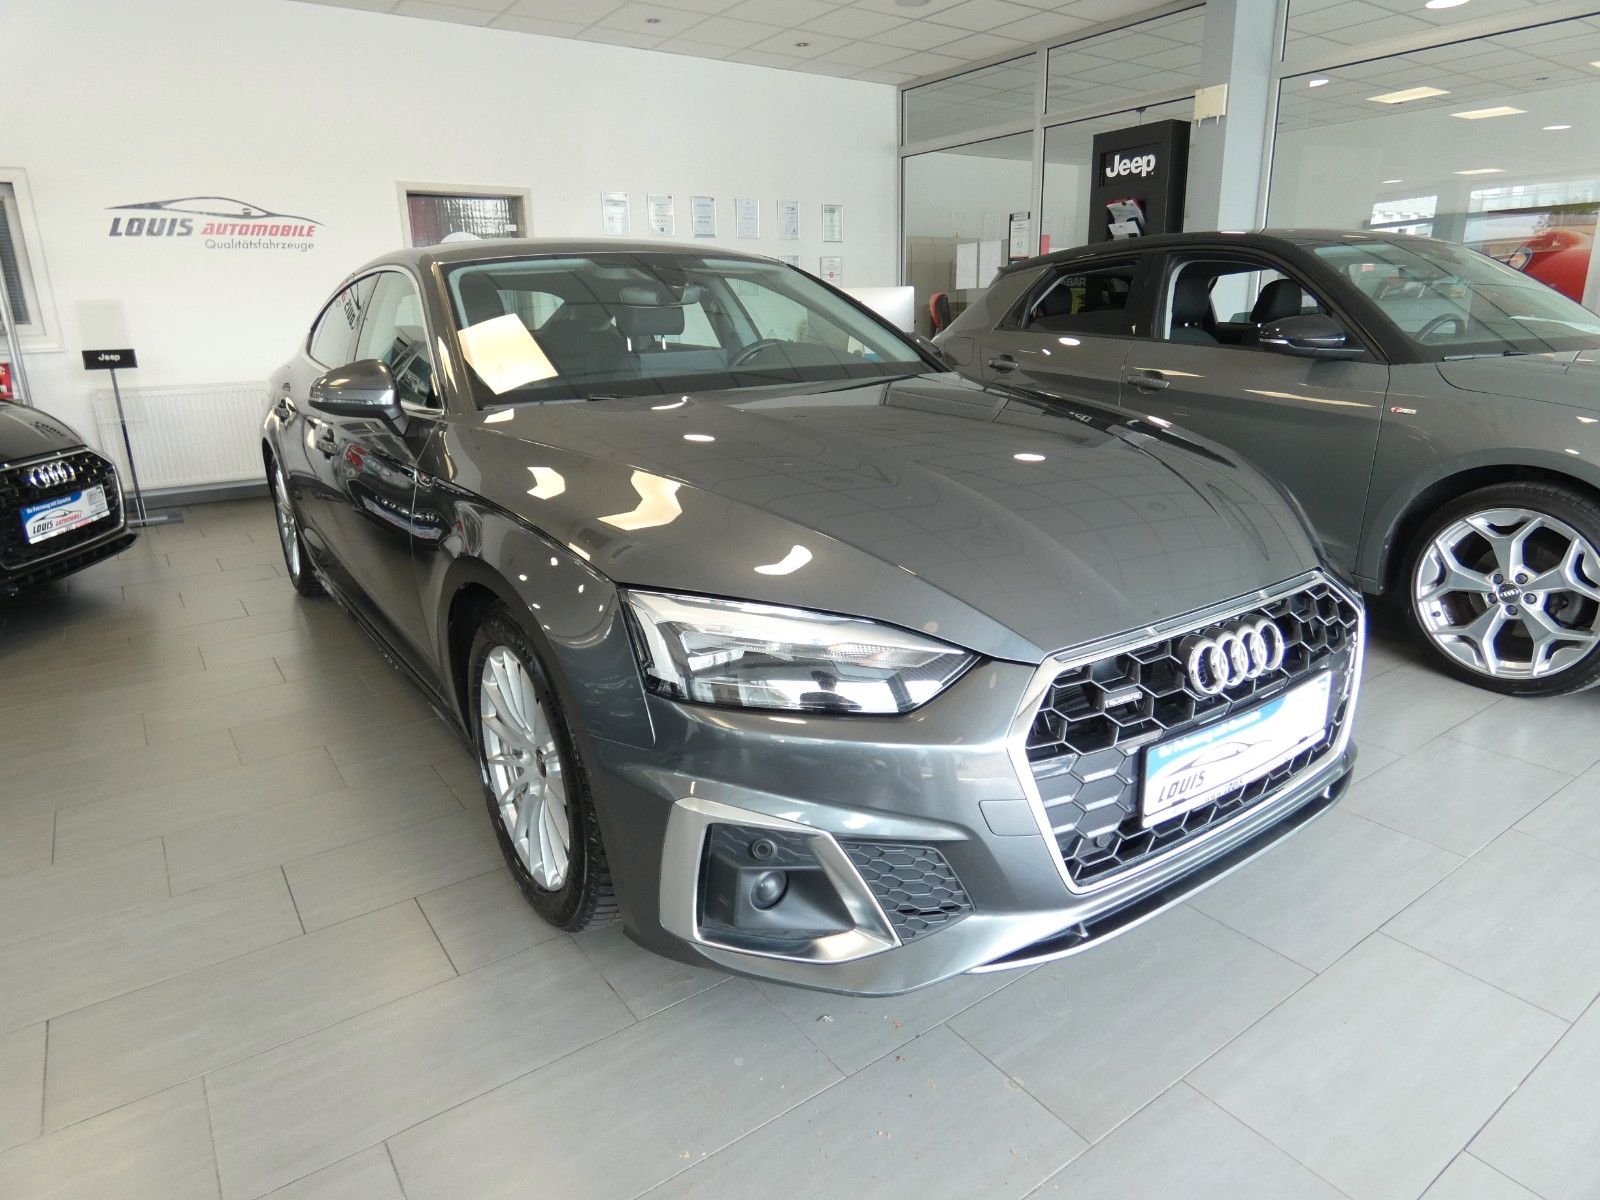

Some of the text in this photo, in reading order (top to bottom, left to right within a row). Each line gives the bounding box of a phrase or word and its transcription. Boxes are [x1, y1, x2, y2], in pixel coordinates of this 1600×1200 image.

[1106, 154, 1155, 177] Jeep
[109, 217, 315, 237] LOUIS AUTOMOBILE
[205, 239, 314, 252] Qualitätsfahrzeuge
[98, 353, 120, 362] Jeep
[33, 521, 53, 534] LOUIS
[1158, 771, 1205, 803] LOUIS
